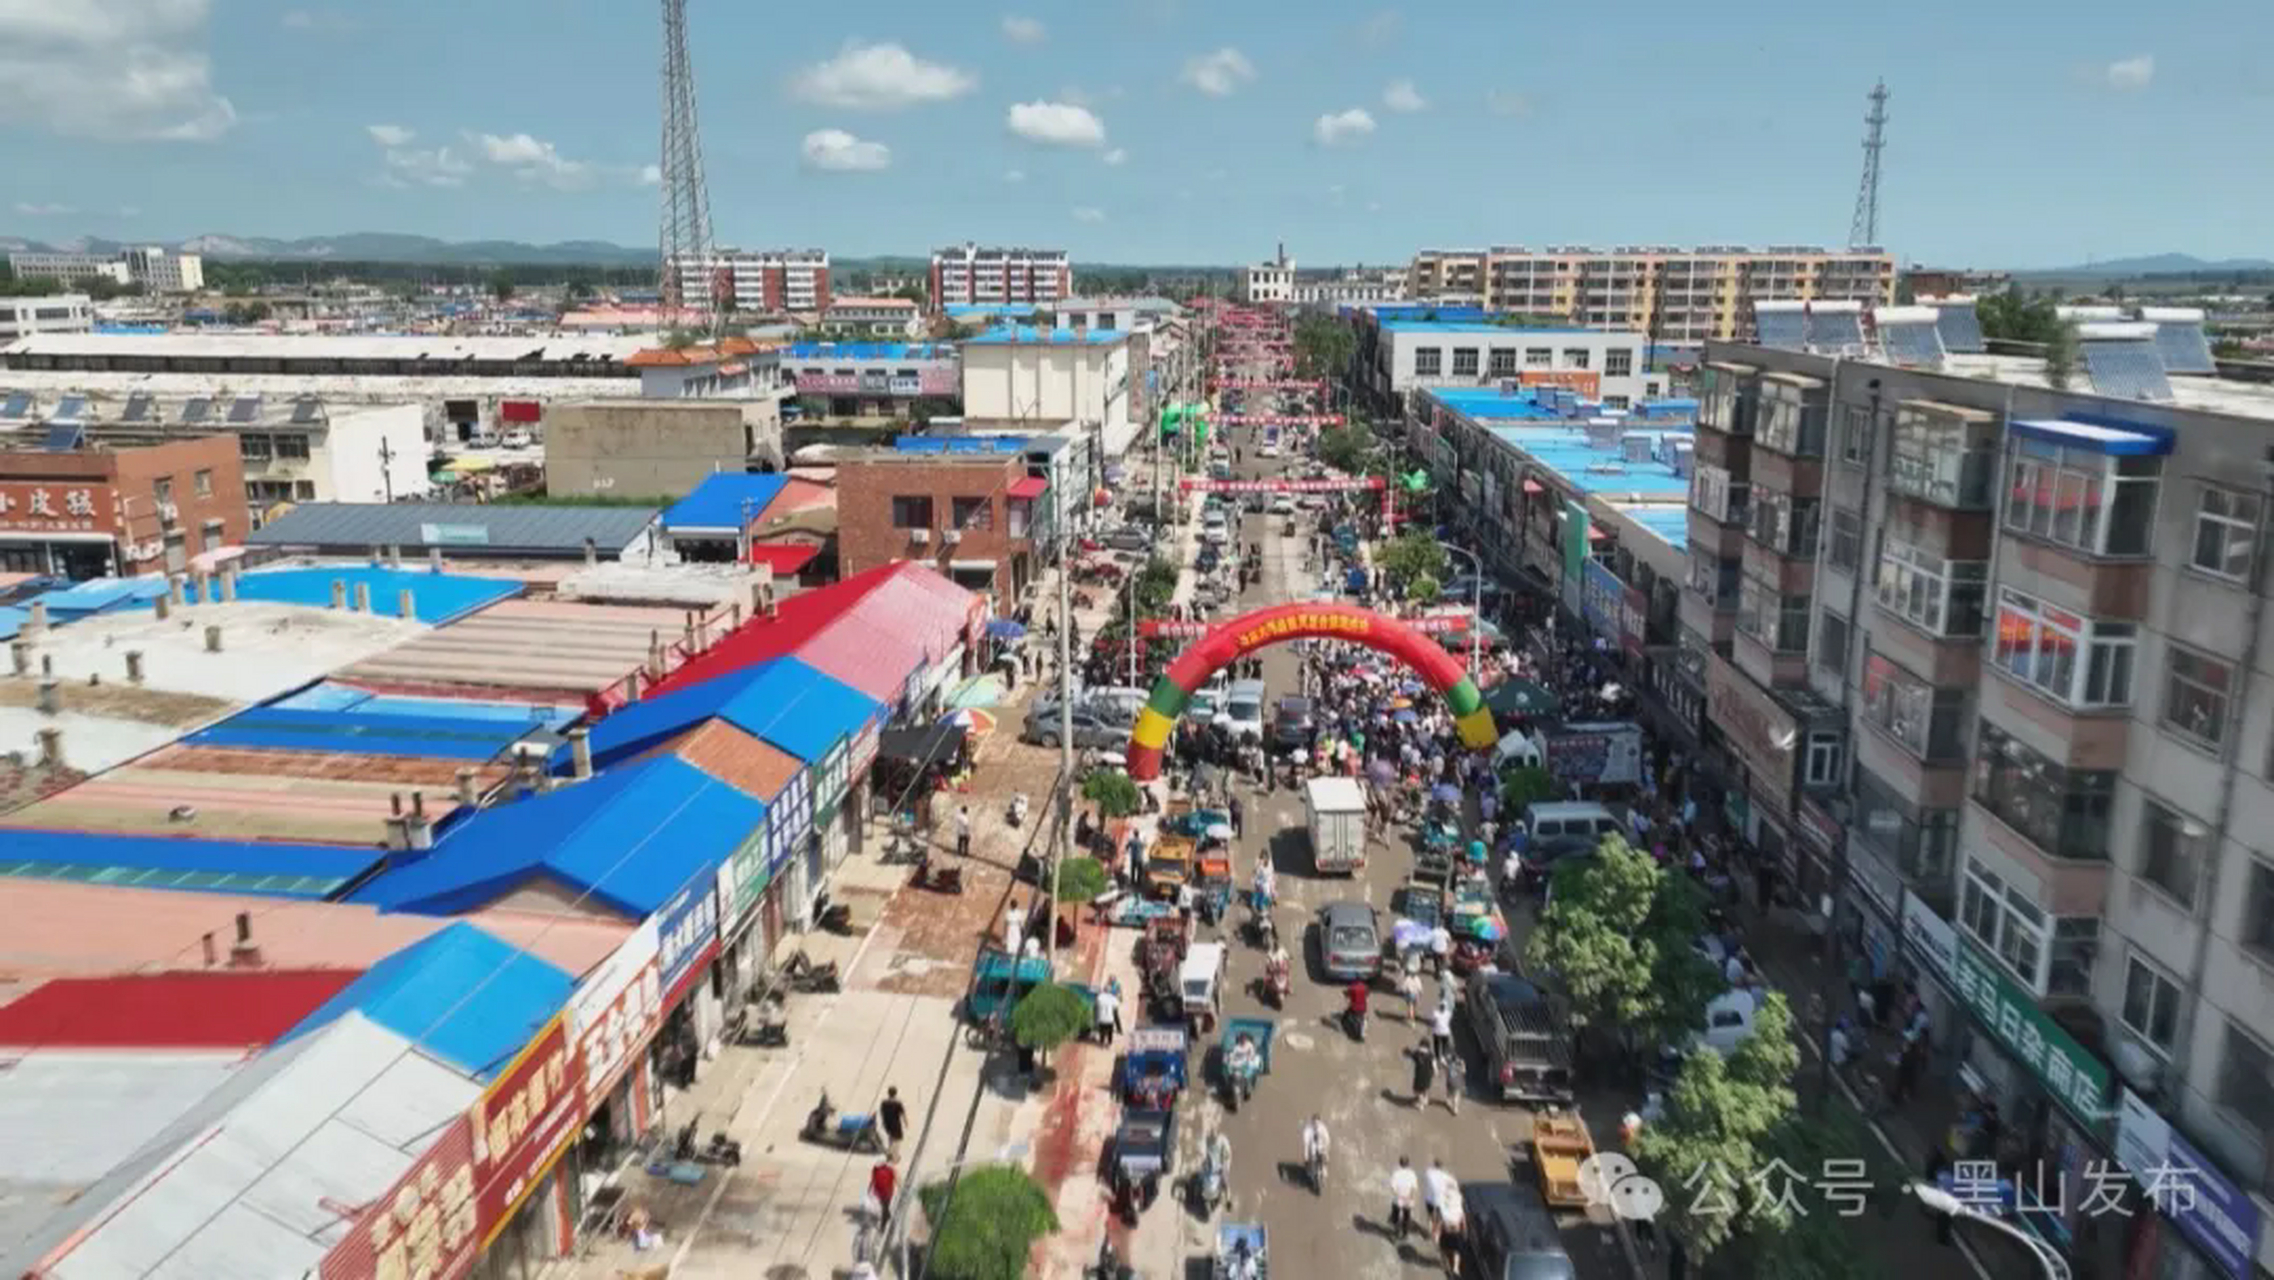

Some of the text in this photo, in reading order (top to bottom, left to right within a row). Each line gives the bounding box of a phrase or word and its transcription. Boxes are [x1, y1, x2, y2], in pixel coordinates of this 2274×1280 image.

[1957, 961, 2101, 1124] 老马日杂商店
